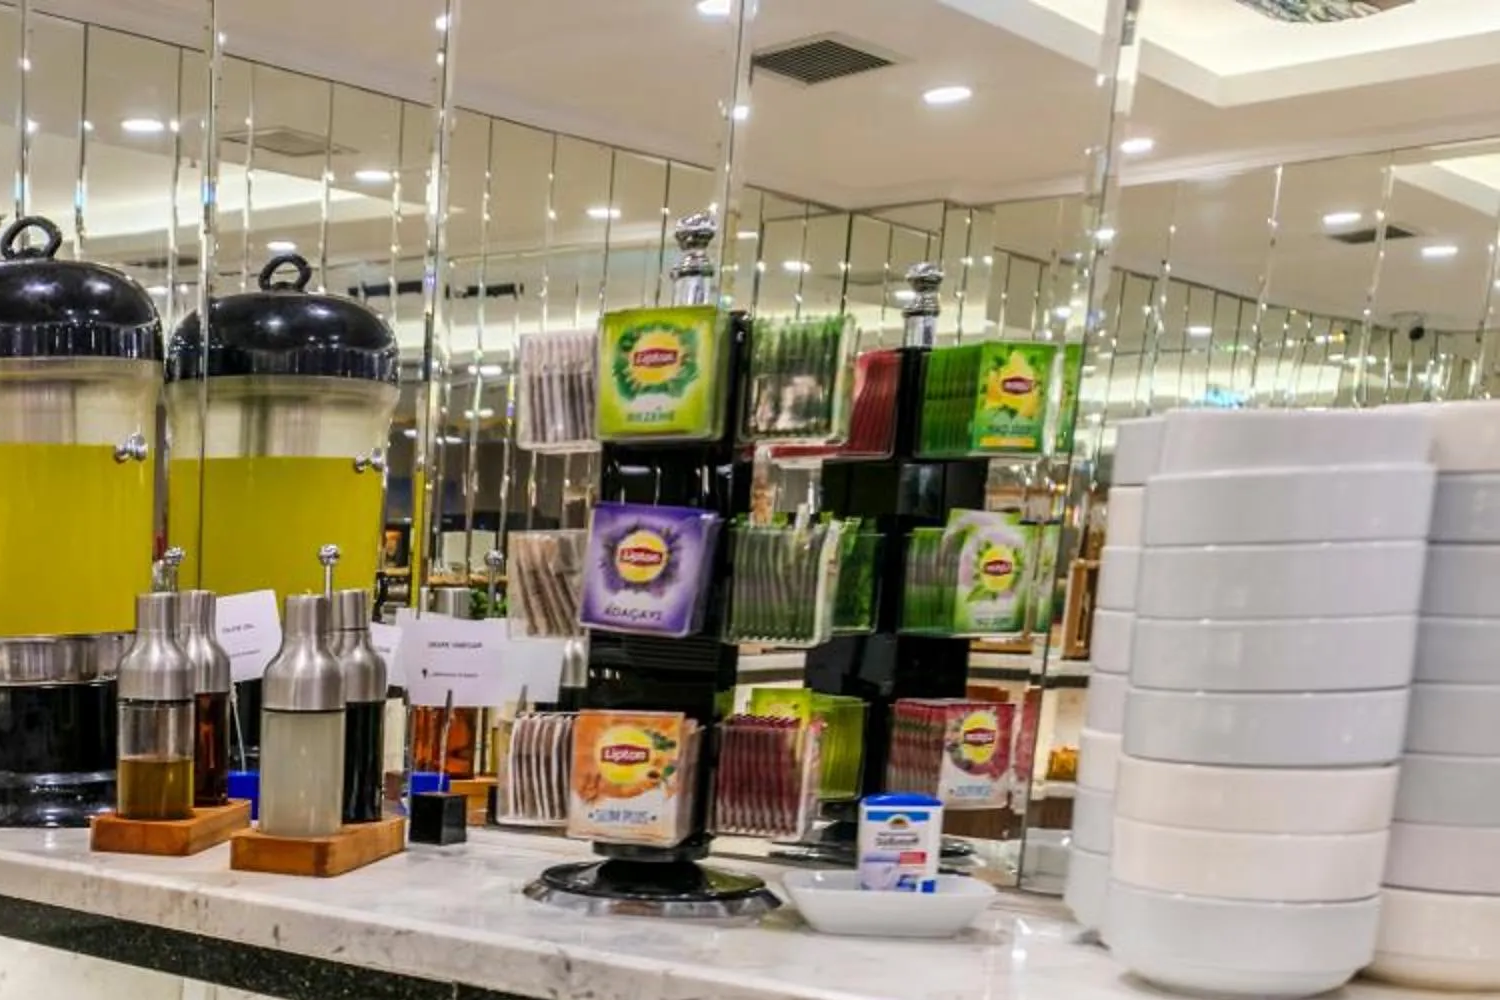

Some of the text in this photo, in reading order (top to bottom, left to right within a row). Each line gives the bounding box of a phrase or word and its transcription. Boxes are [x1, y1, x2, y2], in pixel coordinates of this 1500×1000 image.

[634, 351, 676, 366] Lipton
[619, 549, 661, 563] Lipton
[603, 746, 647, 762] Lipton
